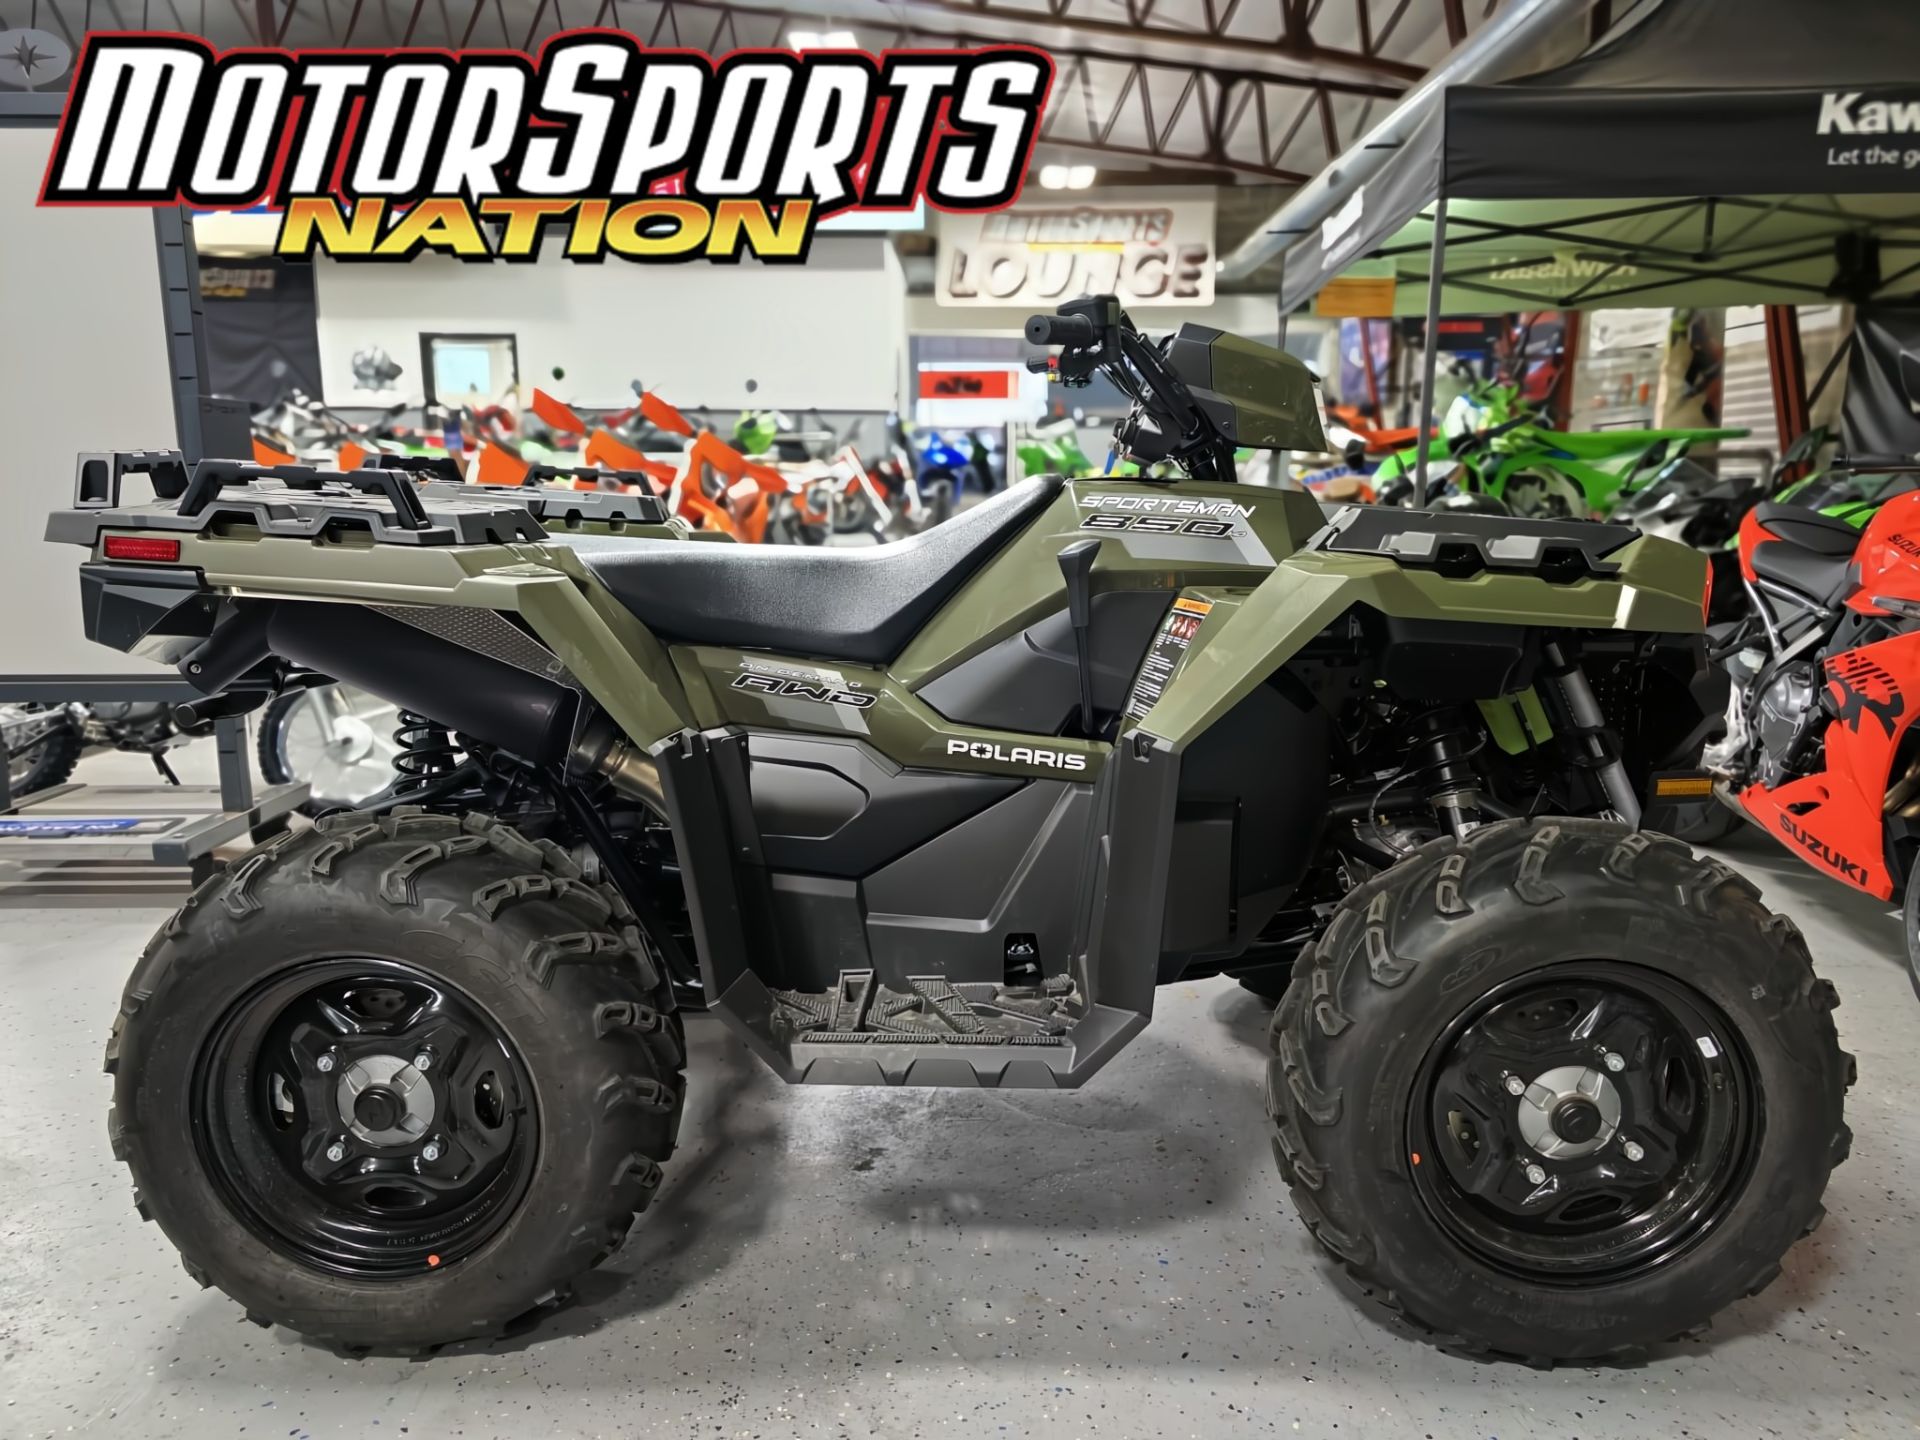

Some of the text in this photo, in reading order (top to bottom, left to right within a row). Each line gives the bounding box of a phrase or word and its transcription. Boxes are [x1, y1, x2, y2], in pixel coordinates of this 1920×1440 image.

[1827, 147, 1860, 166] Let
[1864, 145, 1899, 165] the
[948, 244, 1208, 298] LOUNGE
[1079, 495, 1256, 519] SPORTSMAN
[1079, 513, 1236, 539] 850
[731, 672, 878, 709] AWD
[739, 661, 863, 689] ON DEMAND
[946, 738, 1087, 772] POLARIS
[1780, 812, 1869, 888] SUZUKI
